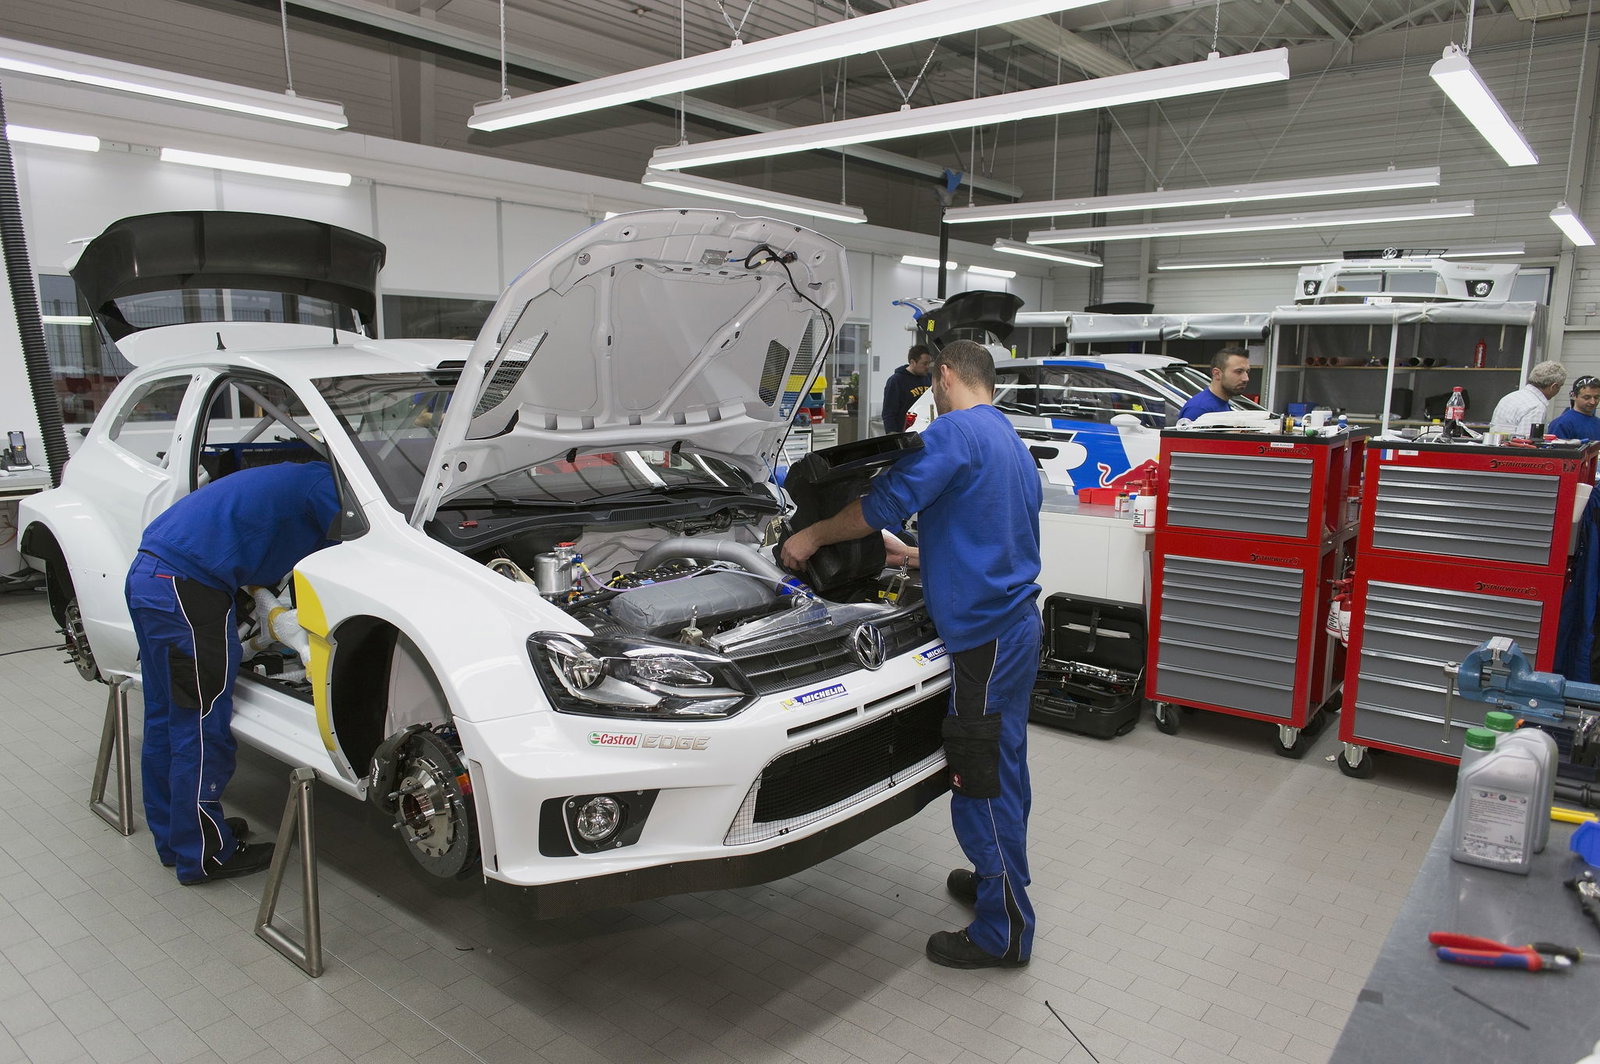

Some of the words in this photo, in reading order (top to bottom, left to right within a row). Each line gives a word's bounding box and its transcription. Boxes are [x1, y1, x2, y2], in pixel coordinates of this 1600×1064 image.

[926, 645, 947, 659] MICHEL
[802, 685, 846, 704] MICHELIN
[600, 733, 638, 746] Castrol
[641, 734, 711, 751] EDGE
